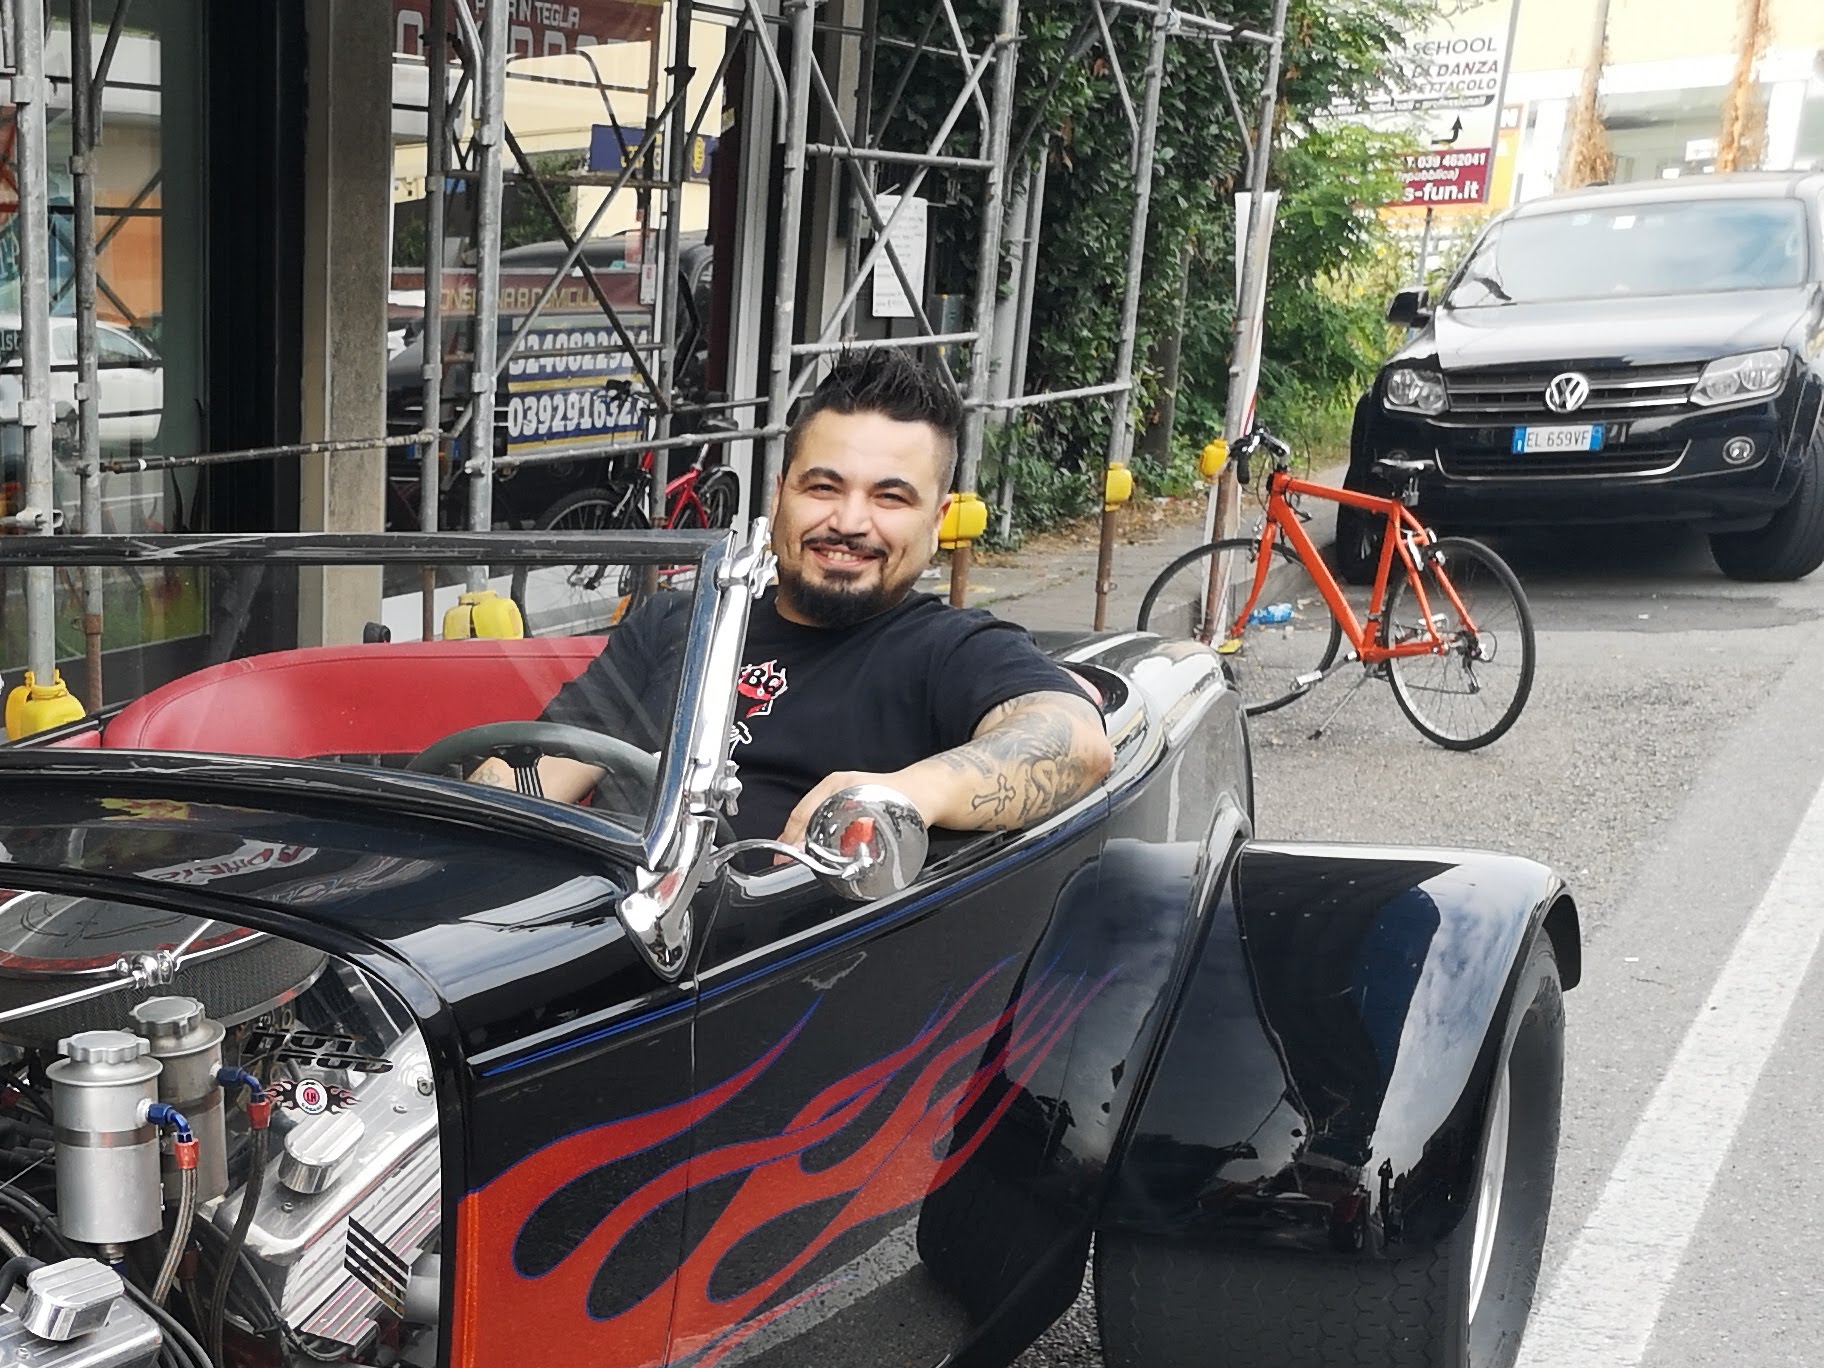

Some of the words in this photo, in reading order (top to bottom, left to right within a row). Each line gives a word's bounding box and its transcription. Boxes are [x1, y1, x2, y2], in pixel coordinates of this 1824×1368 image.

[1412, 37, 1497, 57] SCHOOL
[1436, 60, 1498, 77] DANZA
[1403, 180, 1480, 202] s-fun.it
[1526, 432, 1542, 447] EL
